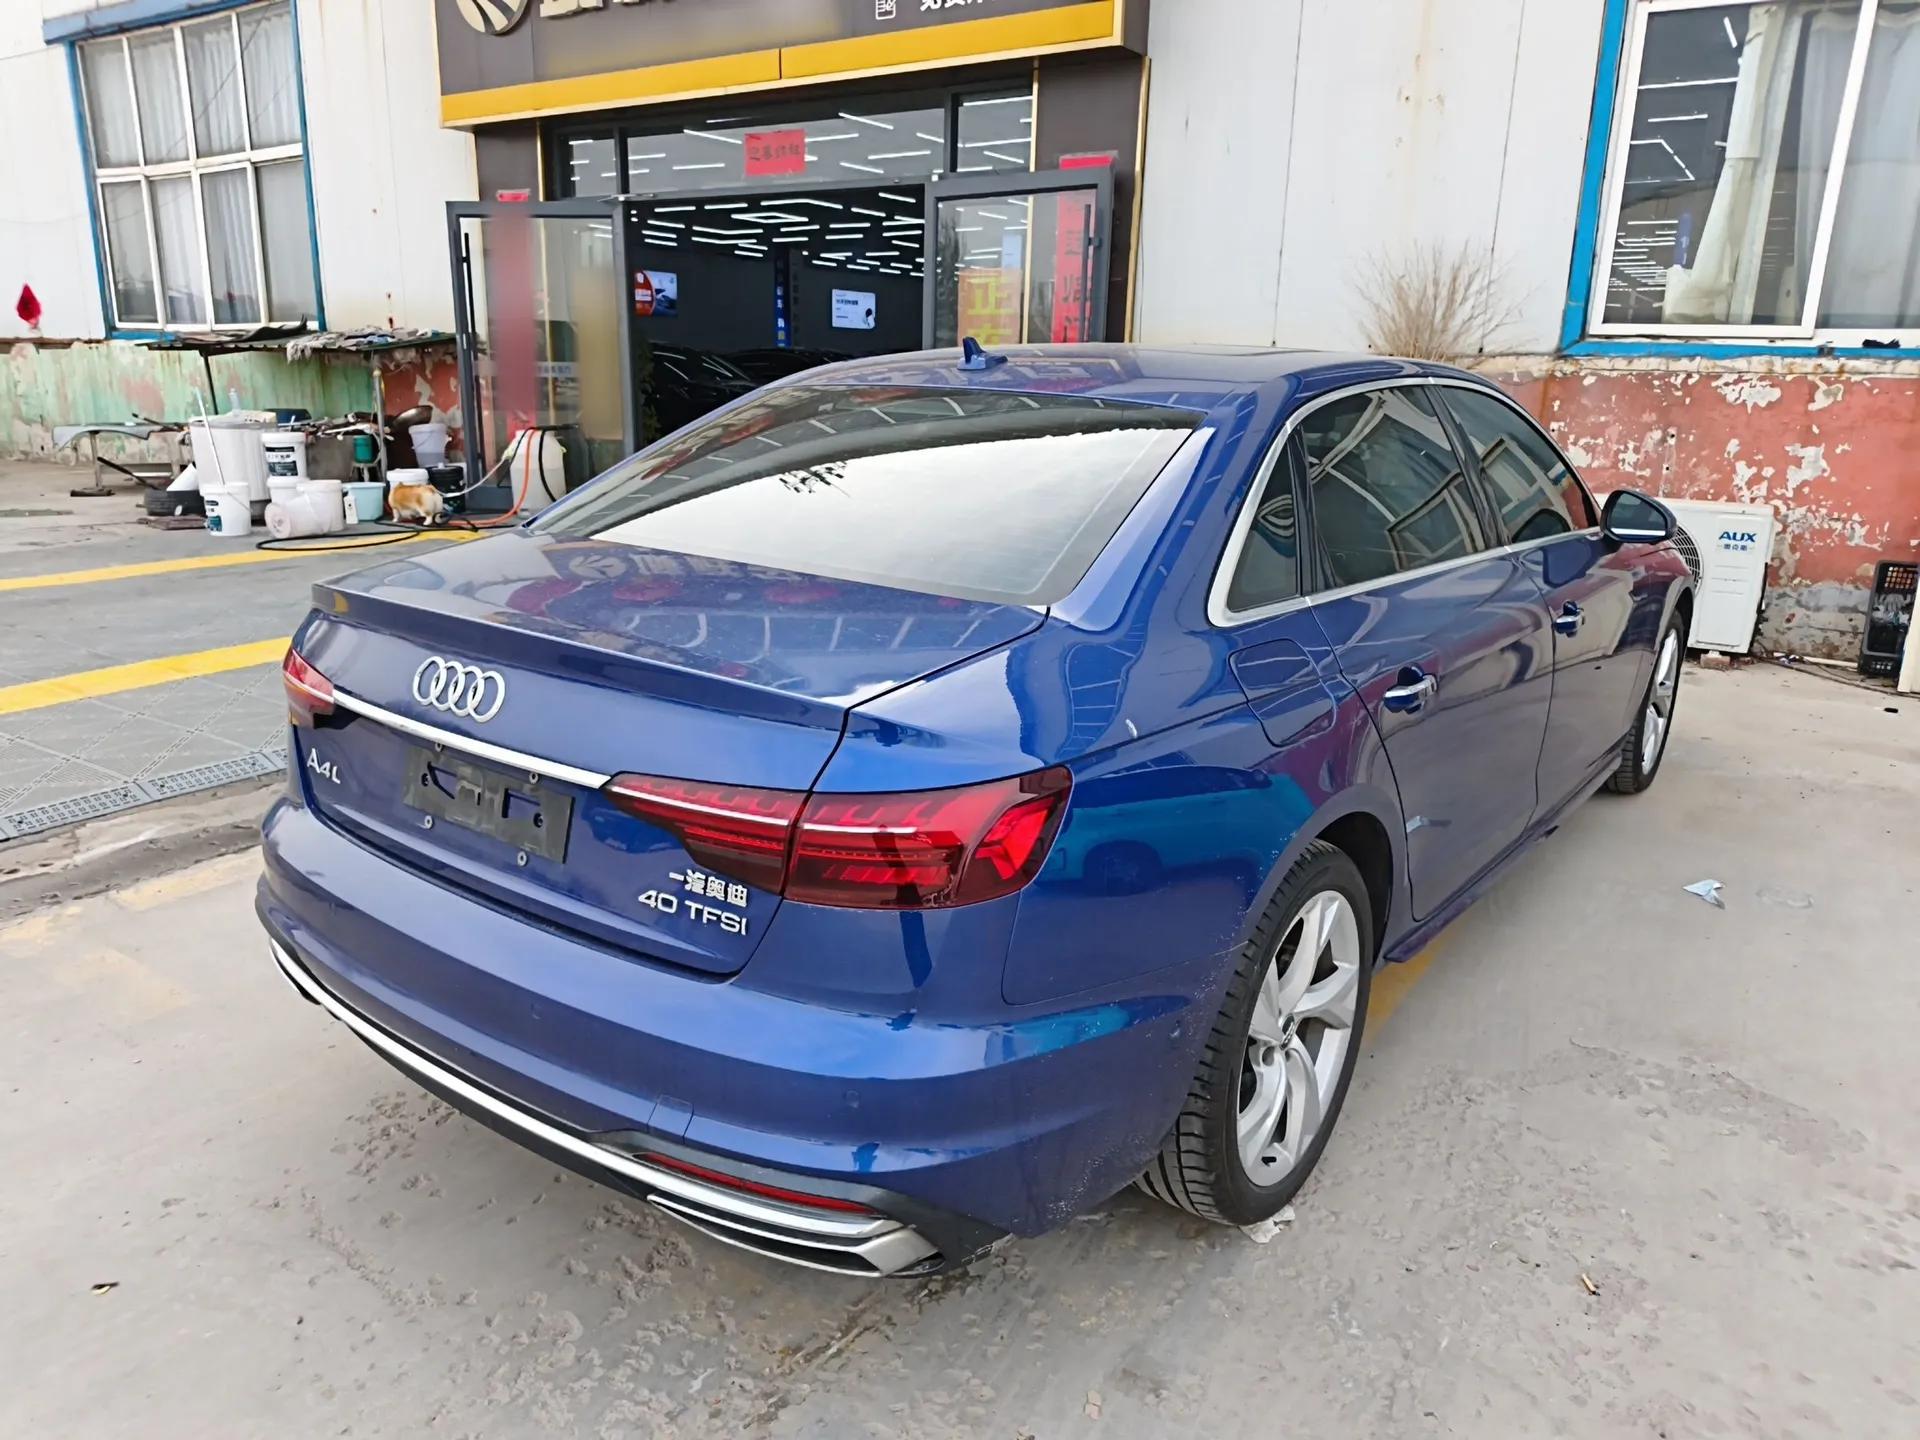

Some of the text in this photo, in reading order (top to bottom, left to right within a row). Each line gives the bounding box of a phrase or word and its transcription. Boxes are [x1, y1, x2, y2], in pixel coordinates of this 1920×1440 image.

[1719, 531, 1757, 543] AUX
[307, 747, 341, 784] A4L
[668, 868, 748, 908] 一汽奥迪
[638, 889, 747, 936] 40 TFSI
